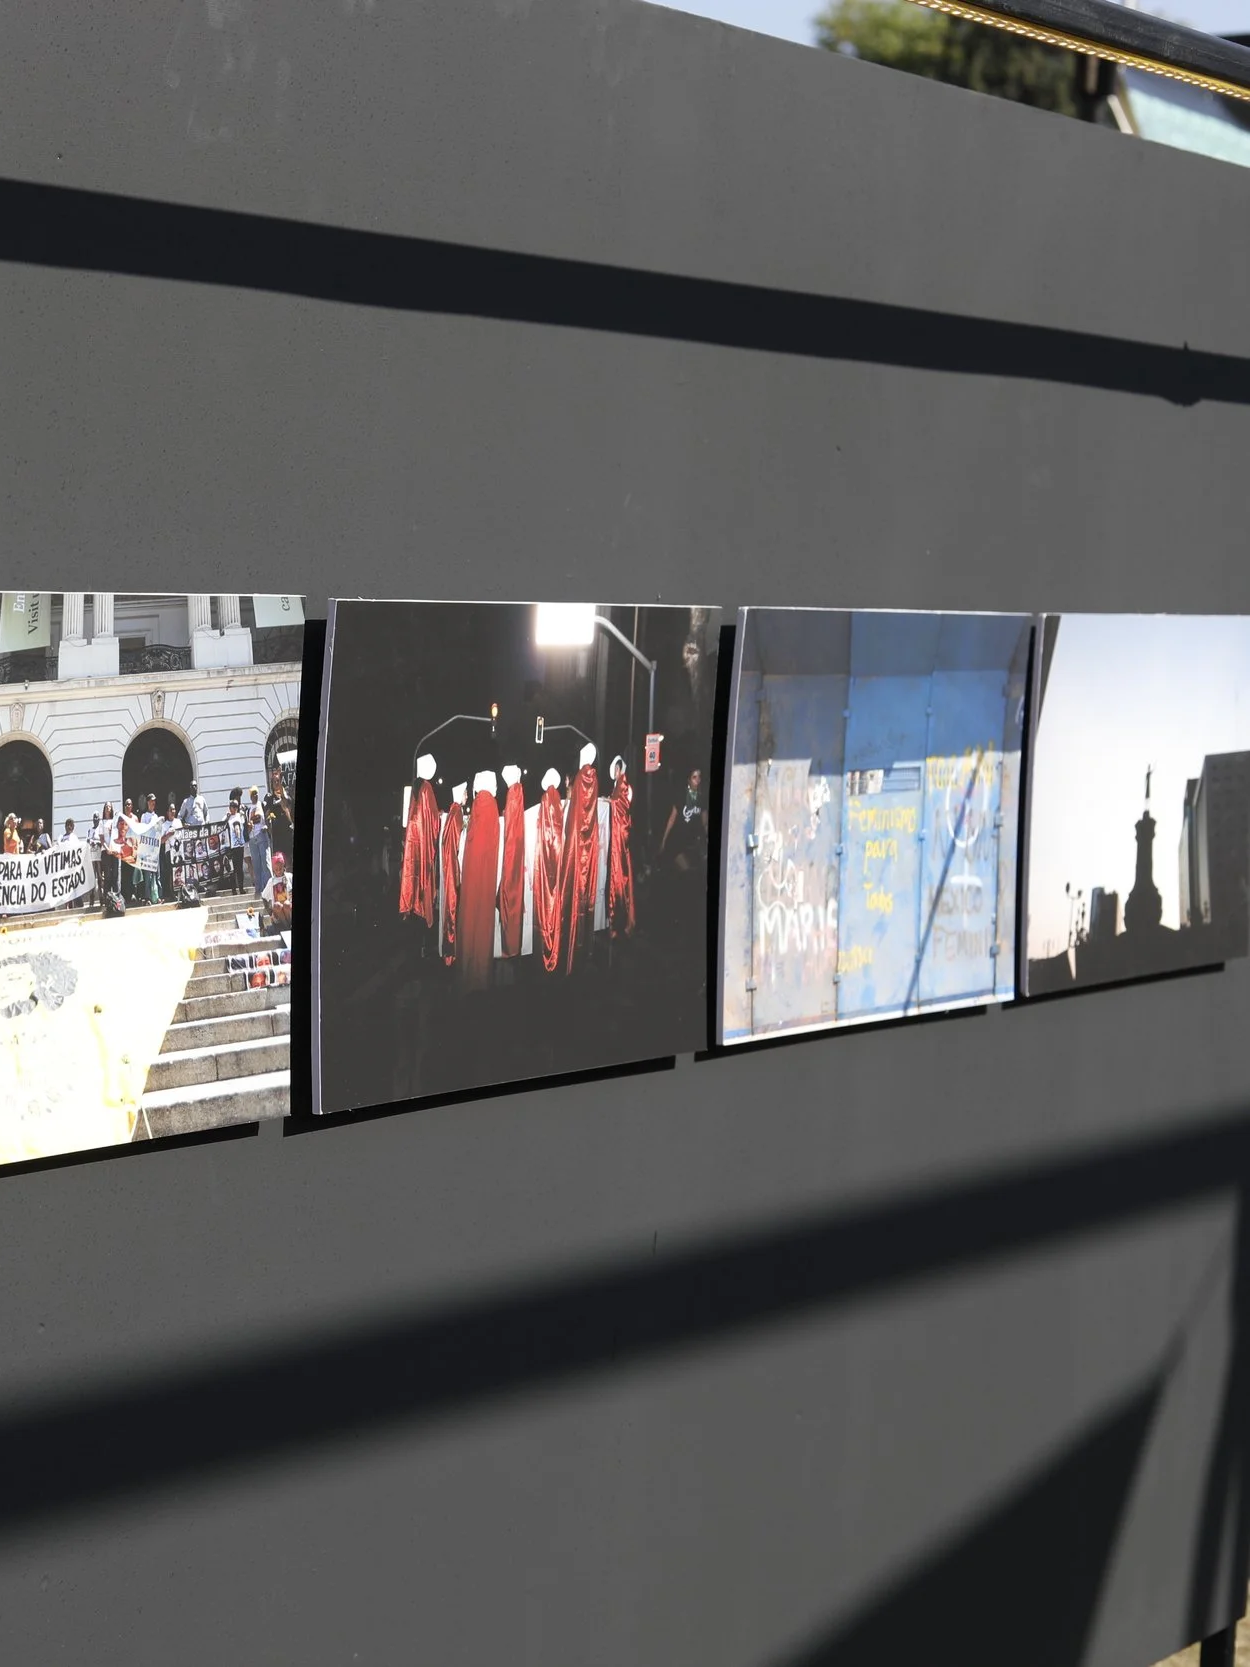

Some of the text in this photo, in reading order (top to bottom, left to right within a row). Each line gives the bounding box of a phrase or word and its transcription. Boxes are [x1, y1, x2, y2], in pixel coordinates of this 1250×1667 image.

[28, 600, 40, 635] Visit
[199, 827, 209, 837] da
[26, 859, 39, 879] AS
[44, 848, 82, 875] VÍTIMAS
[31, 881, 46, 903] DO
[52, 866, 86, 897] ESTADO
